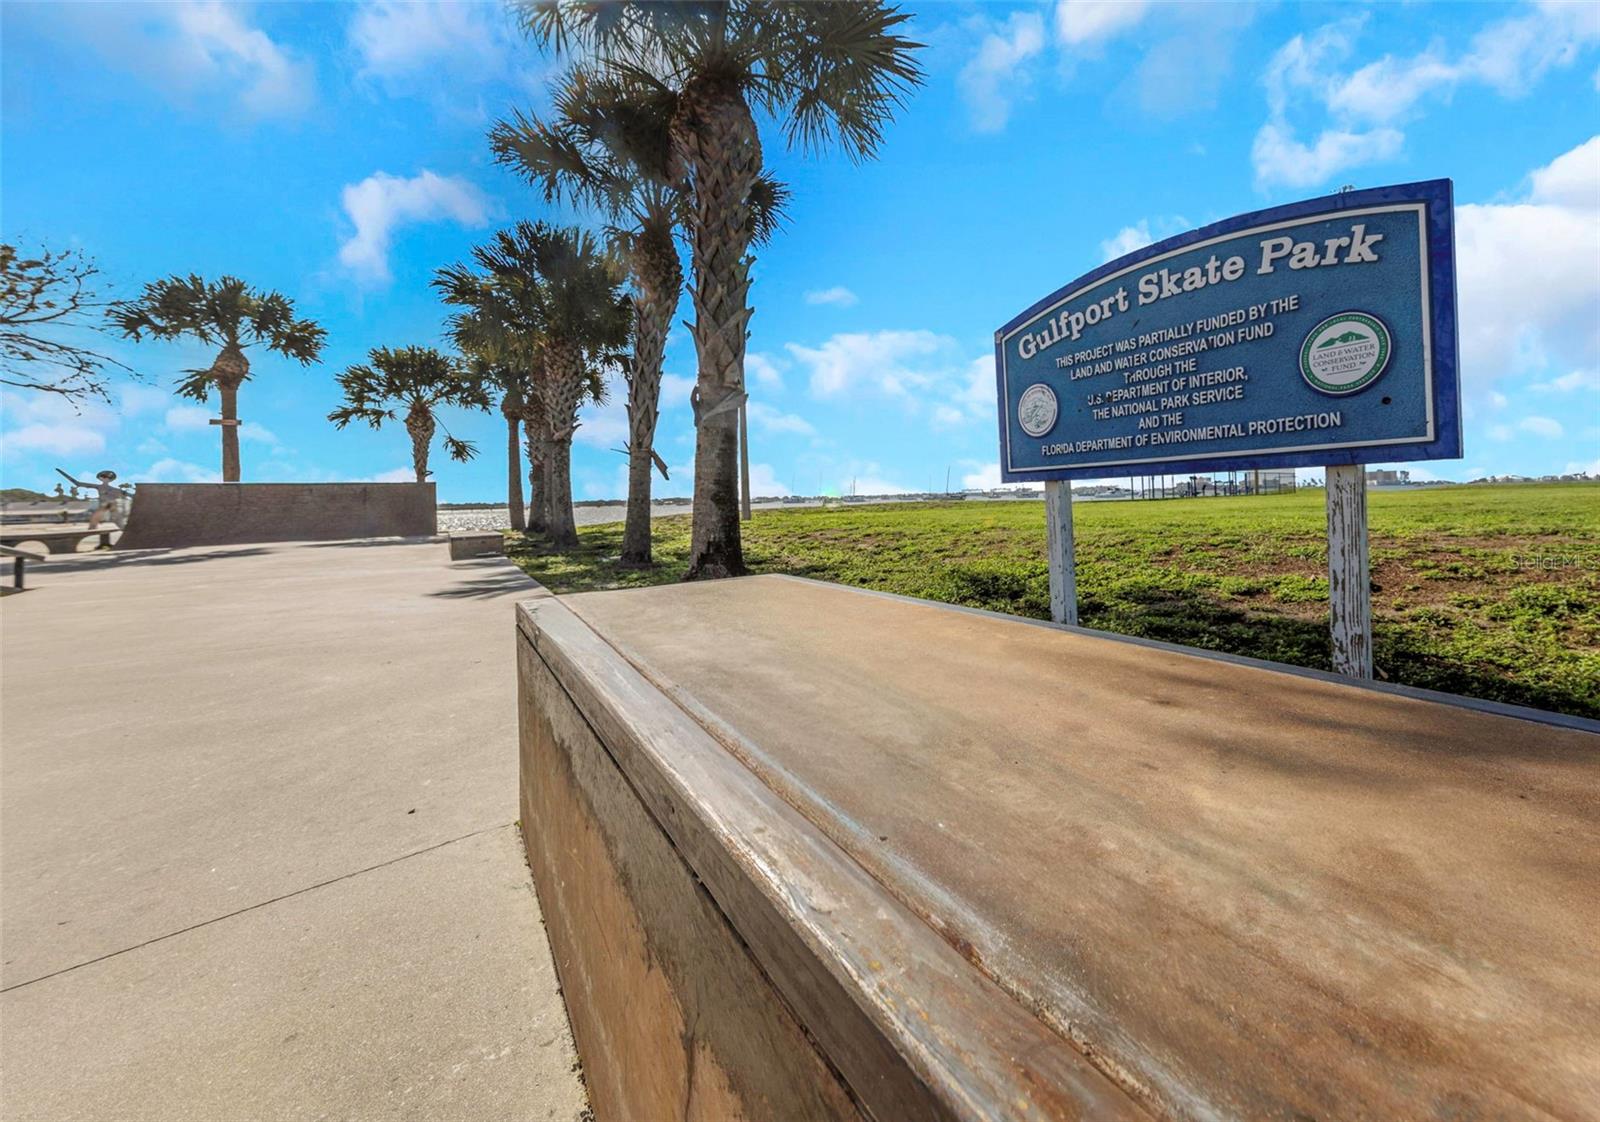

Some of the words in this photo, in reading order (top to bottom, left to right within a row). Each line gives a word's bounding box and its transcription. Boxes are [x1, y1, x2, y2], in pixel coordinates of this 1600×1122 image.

[1018, 287, 1129, 359] Gulfport
[1138, 254, 1245, 306] Skate
[1257, 224, 1382, 275] Park
[1056, 356, 1073, 368] THIS
[1075, 344, 1113, 362] PROJECT
[1115, 338, 1136, 352] WAS
[1138, 323, 1193, 348] PARTIALLY
[1197, 309, 1245, 333] FUNDED
[1249, 303, 1267, 320] BY
[1270, 295, 1299, 314] THE
[1070, 366, 1093, 380] LAND
[1094, 361, 1113, 376] AND
[1114, 355, 1147, 370] WATER
[1149, 331, 1234, 362] CONSERVATION
[1238, 322, 1274, 342] FUND
[1312, 351, 1336, 361] LAND
[1343, 343, 1376, 356] WATER
[1313, 351, 1376, 368] CONSERVATION
[1123, 365, 1172, 384] THROUGH
[1174, 358, 1197, 373] THE
[1171, 378, 1188, 391] OF
[1189, 367, 1248, 388] INTERIOR,
[1331, 362, 1356, 372] FUND
[1093, 409, 1110, 421] THE
[1111, 400, 1159, 419] NATIONAL
[1160, 394, 1189, 411] PARK
[1192, 385, 1244, 406] SERVICE
[1042, 442, 1074, 456] FLORIDA
[1075, 436, 1133, 453] DEPARTMENT
[1135, 433, 1149, 447] OF
[1150, 423, 1246, 445] ENVIRONMENTAL
[1248, 411, 1342, 436] PROTECTION
[1138, 417, 1160, 430] AND
[1163, 412, 1183, 427] THE
